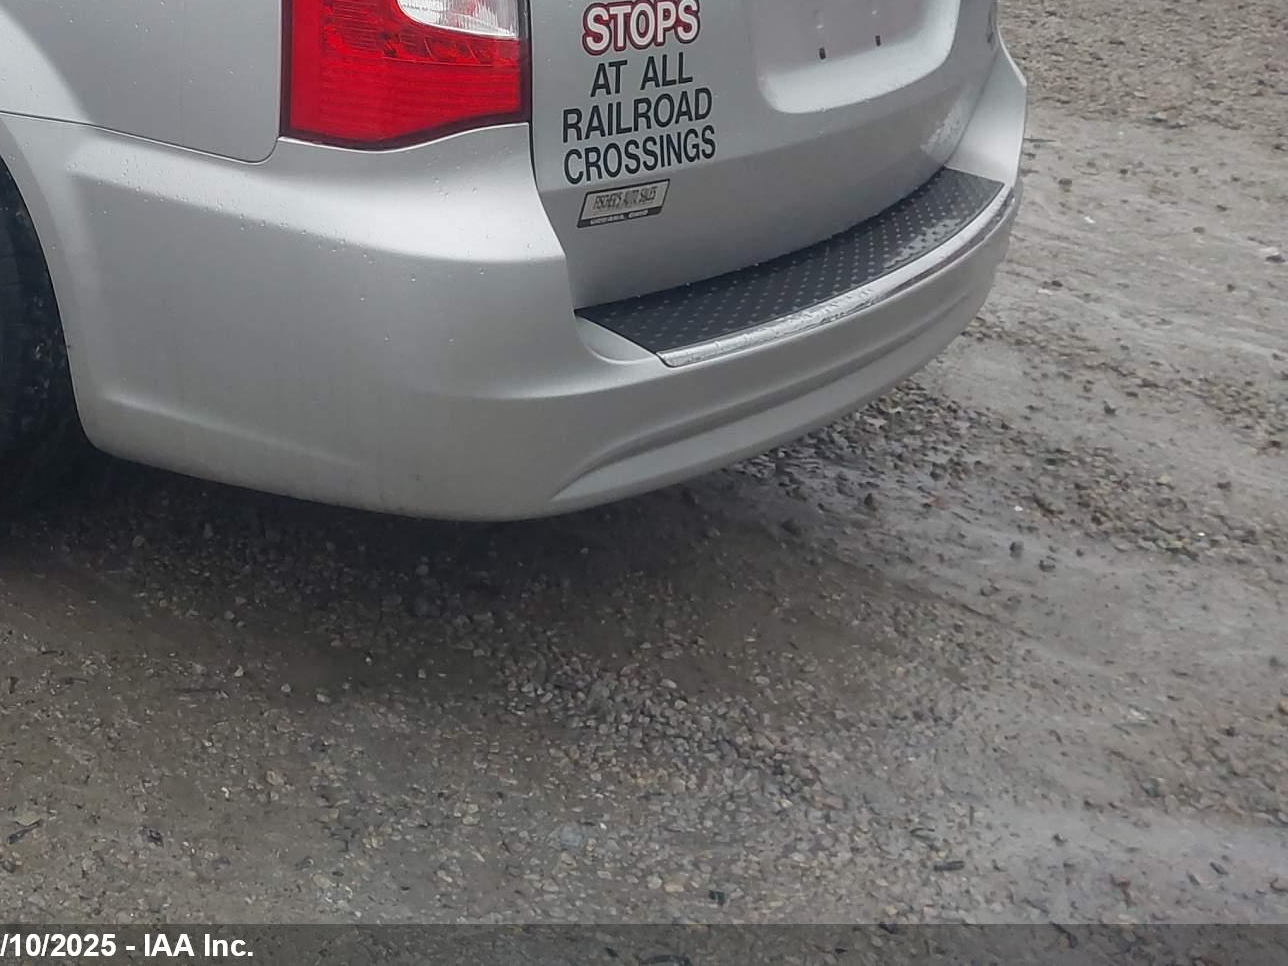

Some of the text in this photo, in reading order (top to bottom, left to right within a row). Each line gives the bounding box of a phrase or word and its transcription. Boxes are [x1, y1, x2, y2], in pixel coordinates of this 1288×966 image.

[590, 51, 693, 98] AT ALL
[562, 87, 712, 144] RAILROAD
[563, 124, 717, 185] CROSSINGS
